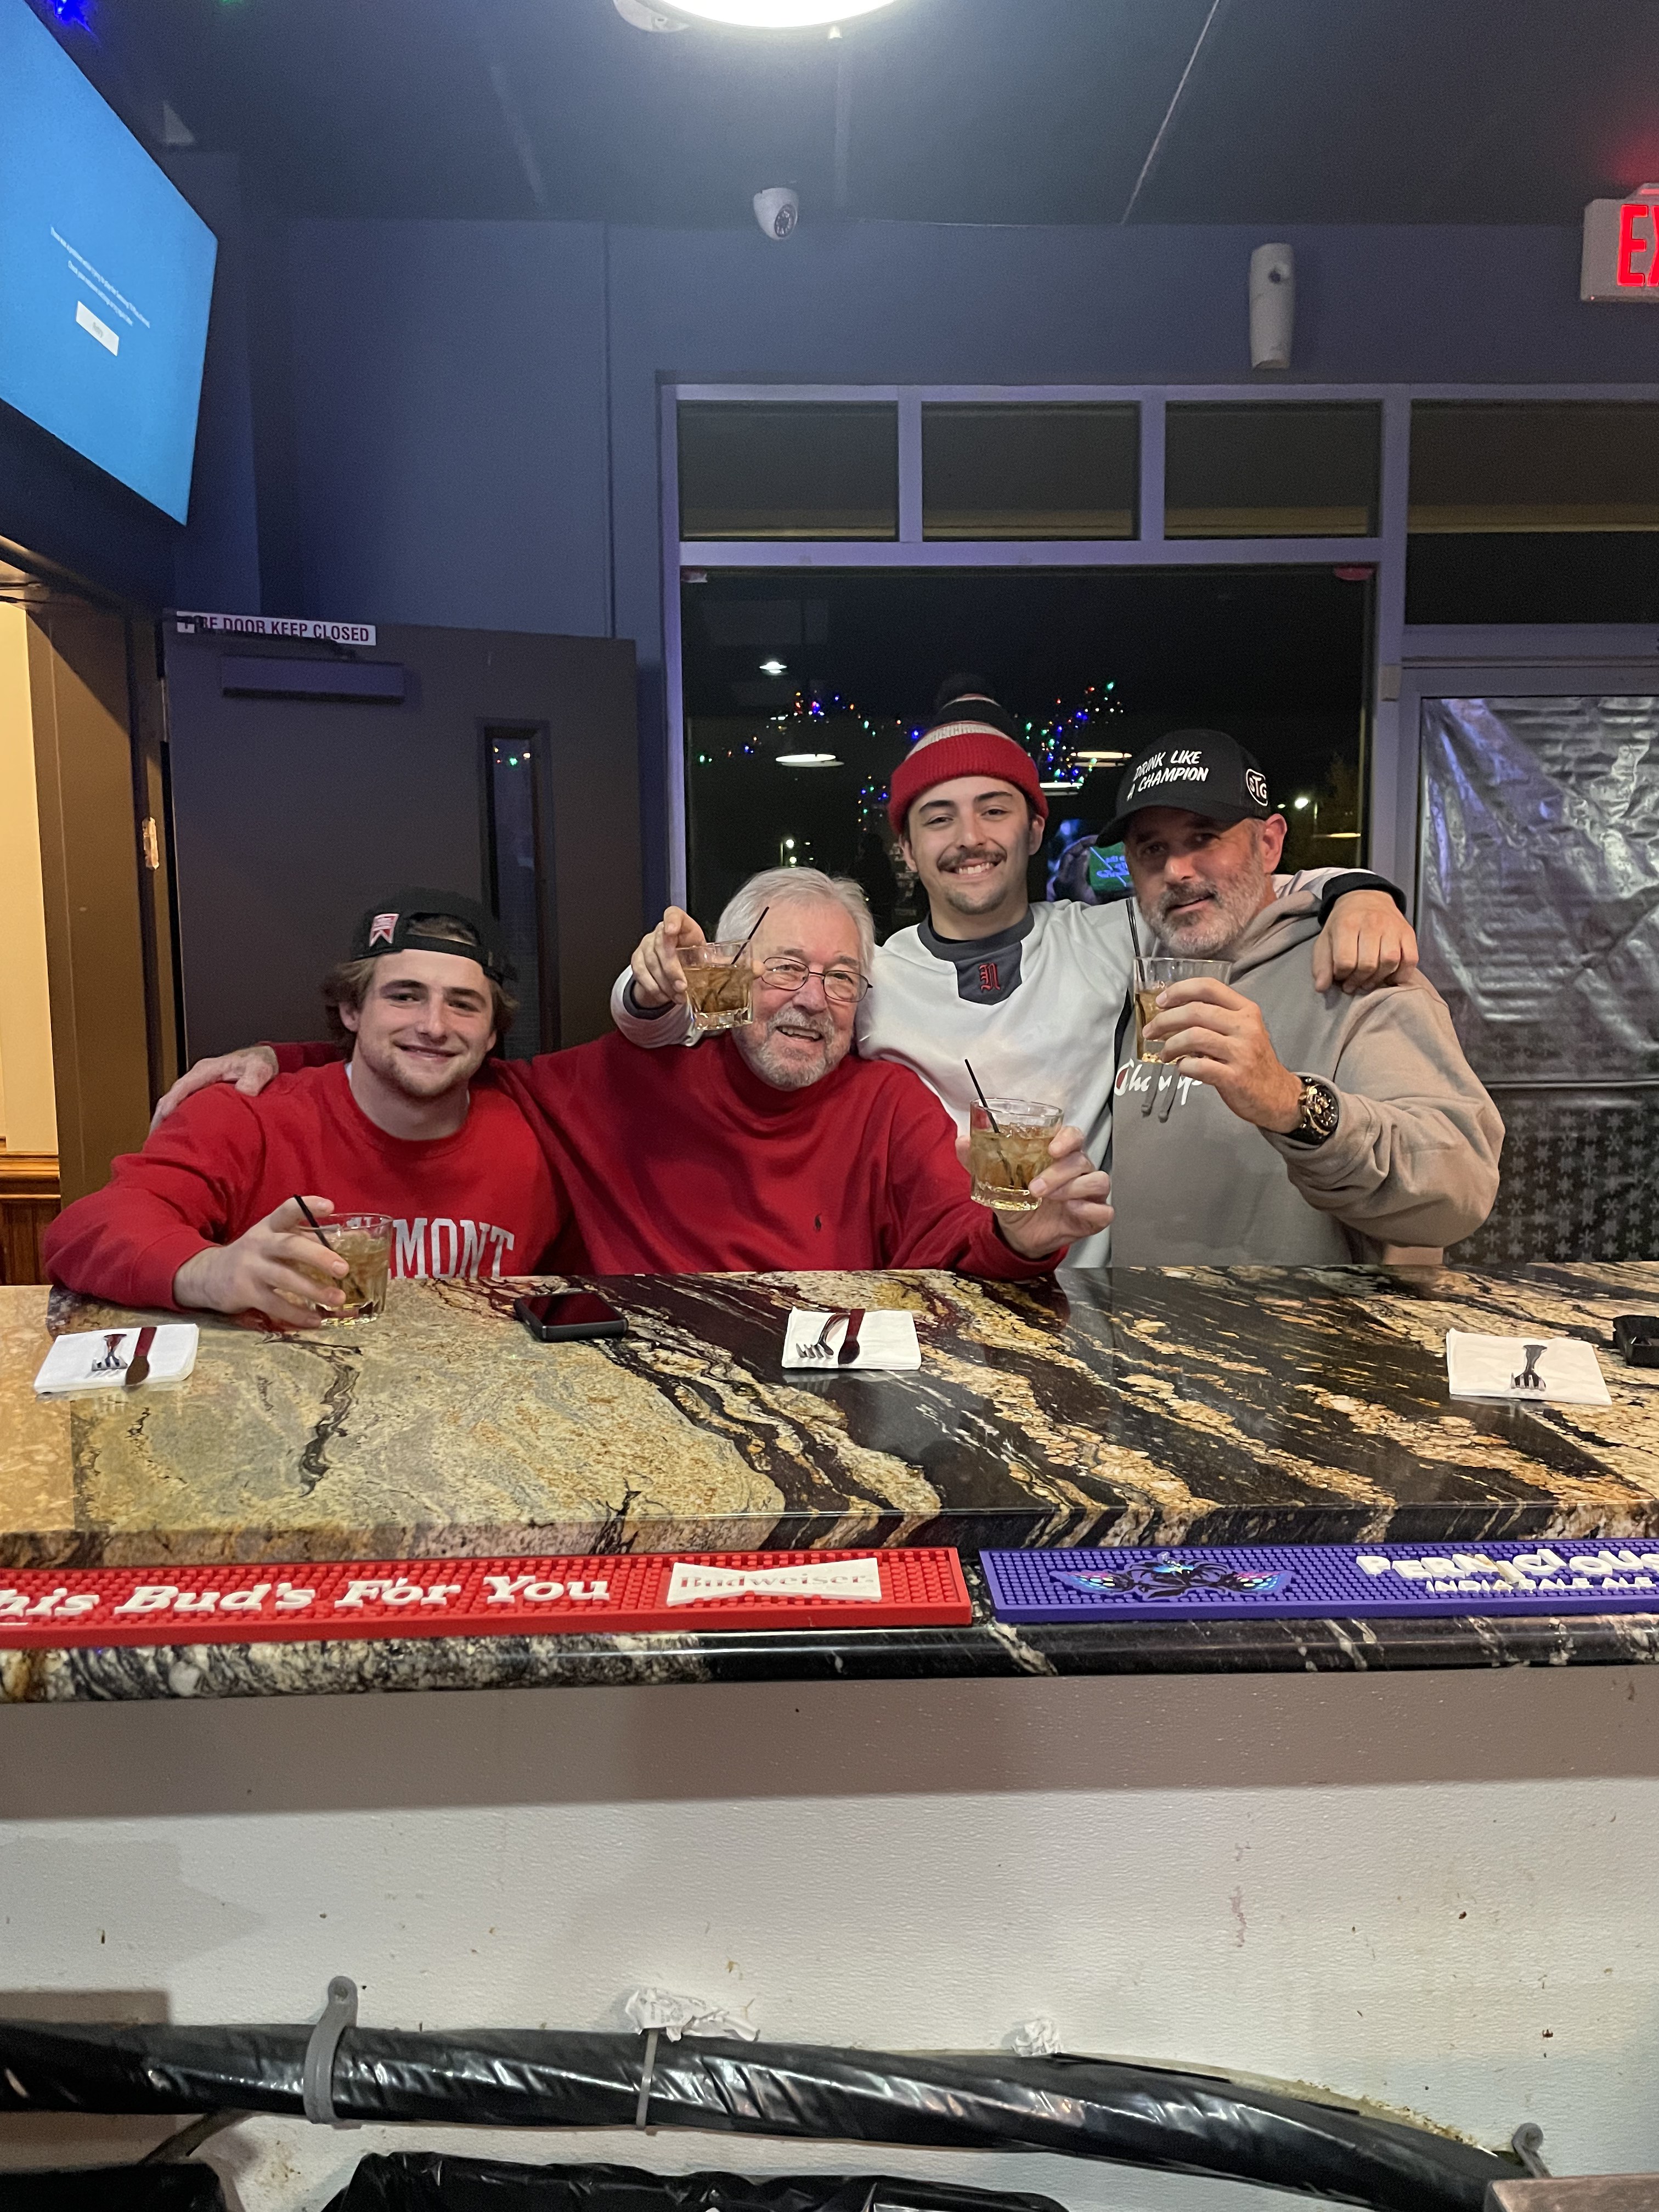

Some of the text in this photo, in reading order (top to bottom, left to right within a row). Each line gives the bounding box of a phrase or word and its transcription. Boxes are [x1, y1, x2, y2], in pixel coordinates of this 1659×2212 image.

[223, 617, 266, 633] DOOR
[271, 621, 308, 637] KEEP
[313, 624, 369, 642] CLOSED
[1133, 749, 1202, 781] DRINK LIKE
[1126, 767, 1209, 802] A CHAMPION
[351, 1217, 515, 1283] MONT
[114, 1583, 316, 1615] Bud's
[484, 1575, 611, 1605] You
[1426, 1576, 1657, 1594] INDIA PALE ALE
